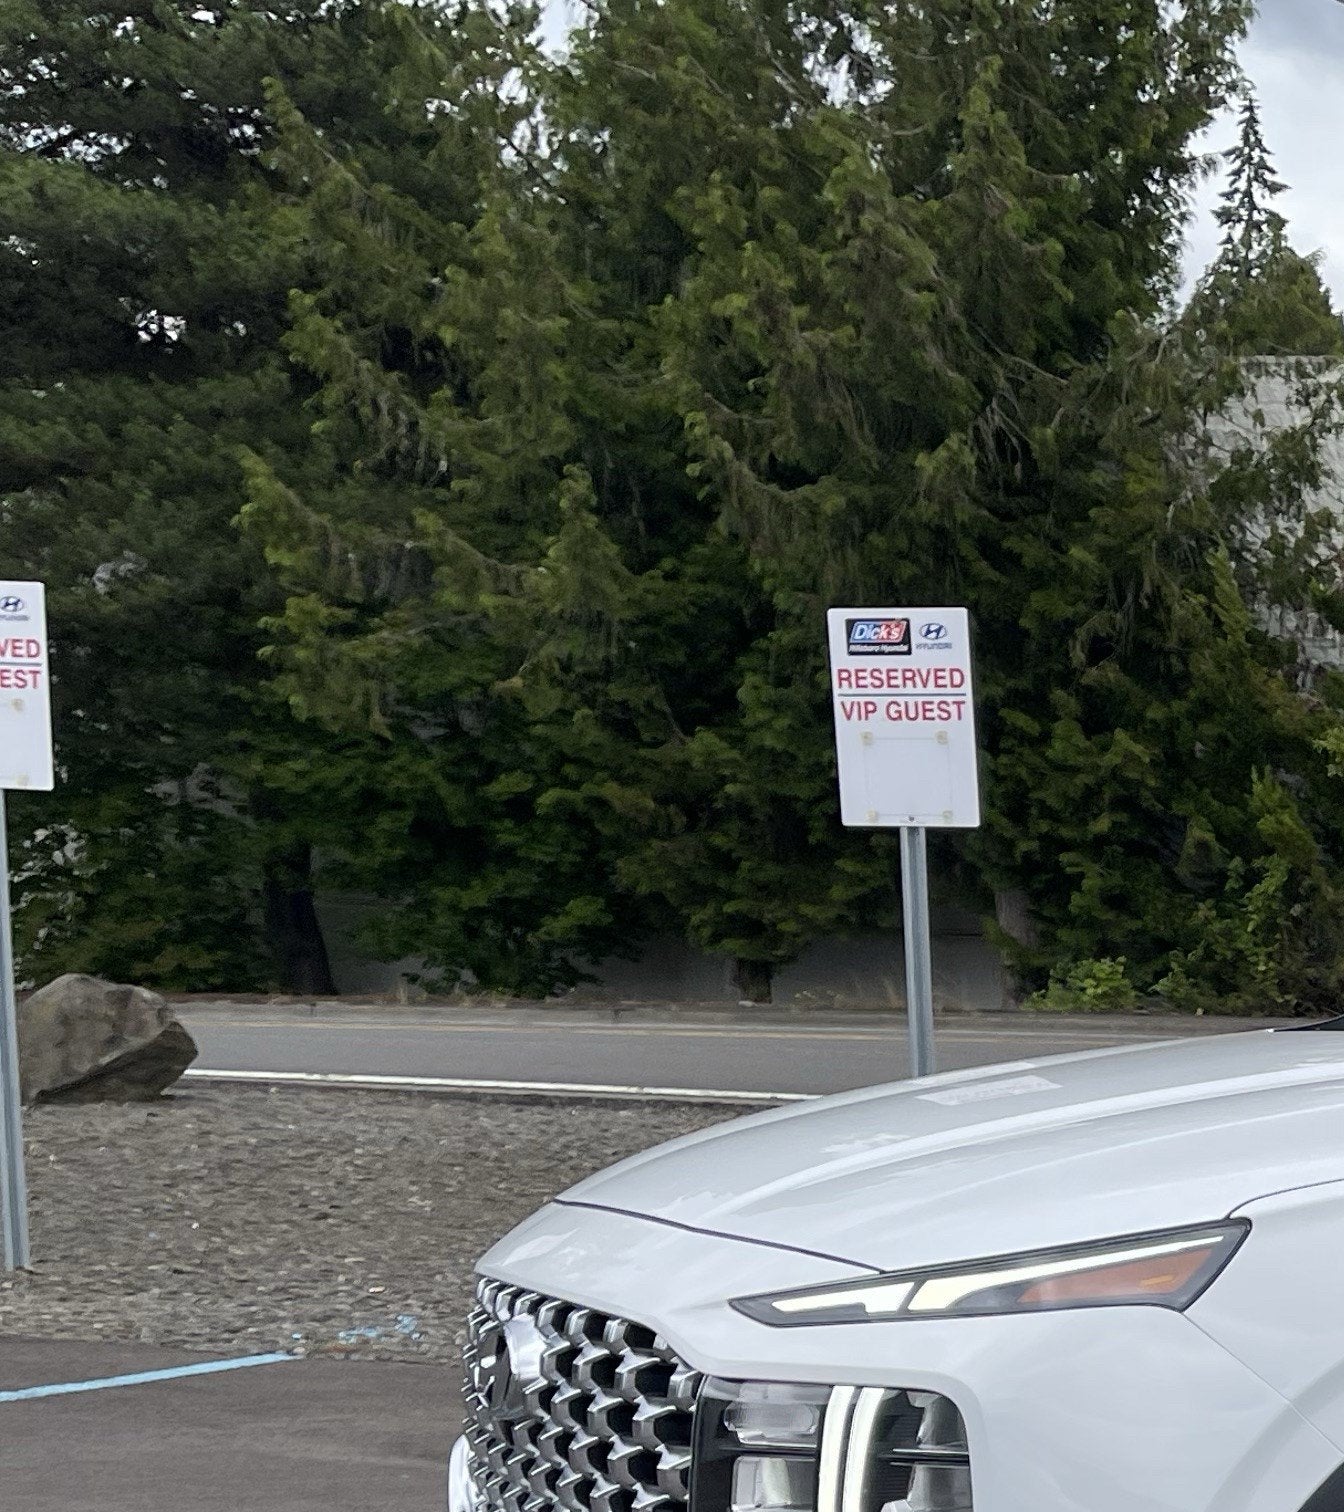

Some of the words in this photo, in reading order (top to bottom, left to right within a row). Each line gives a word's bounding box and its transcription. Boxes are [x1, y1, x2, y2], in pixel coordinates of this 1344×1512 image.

[837, 667, 964, 689] RESERVED
[841, 701, 877, 721] VIP
[886, 700, 965, 721] GUEST
